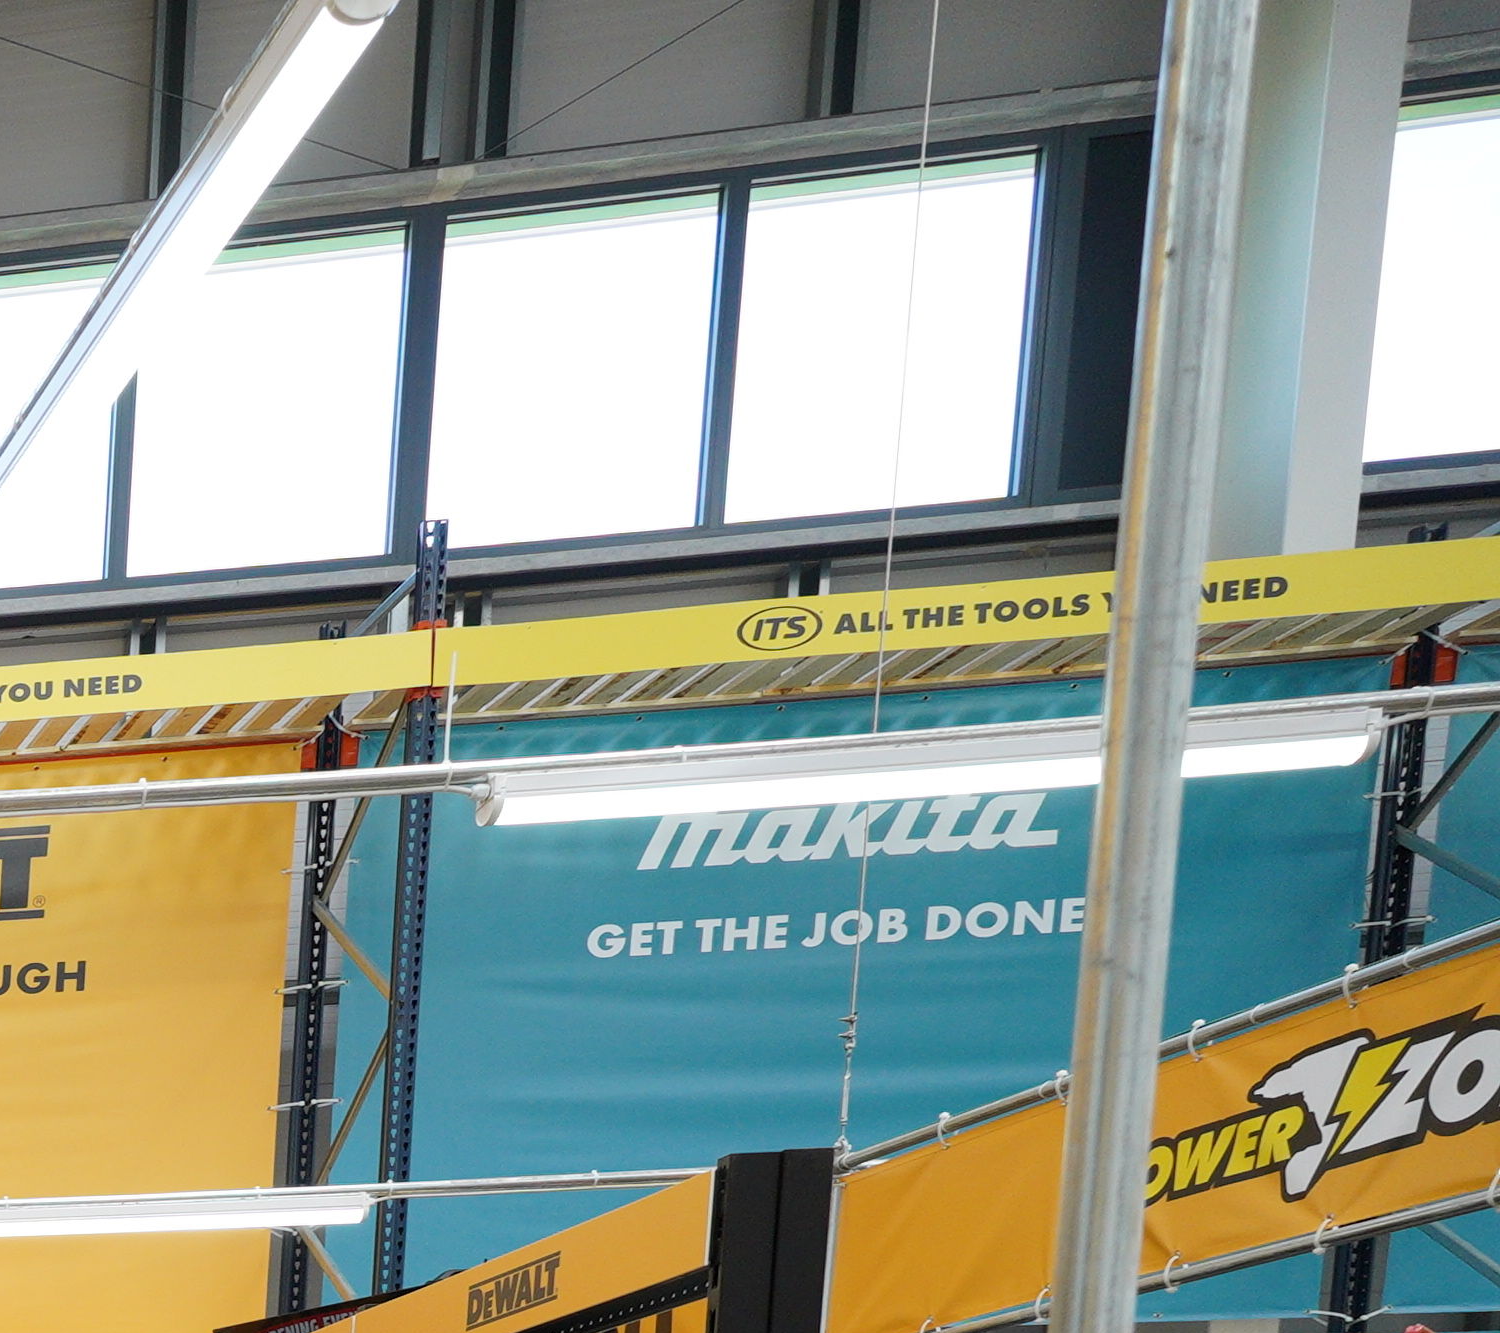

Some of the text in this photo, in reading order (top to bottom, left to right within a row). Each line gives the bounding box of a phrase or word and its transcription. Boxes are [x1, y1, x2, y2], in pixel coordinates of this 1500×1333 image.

[754, 594, 1089, 642] ITS ALL THE TOOLS
[64, 674, 143, 698] NEED
[639, 793, 1058, 871] makita
[587, 898, 1087, 959] GET THE JOB DONE
[1150, 1107, 1304, 1201] OWER
[467, 1260, 558, 1326] DEWALT
